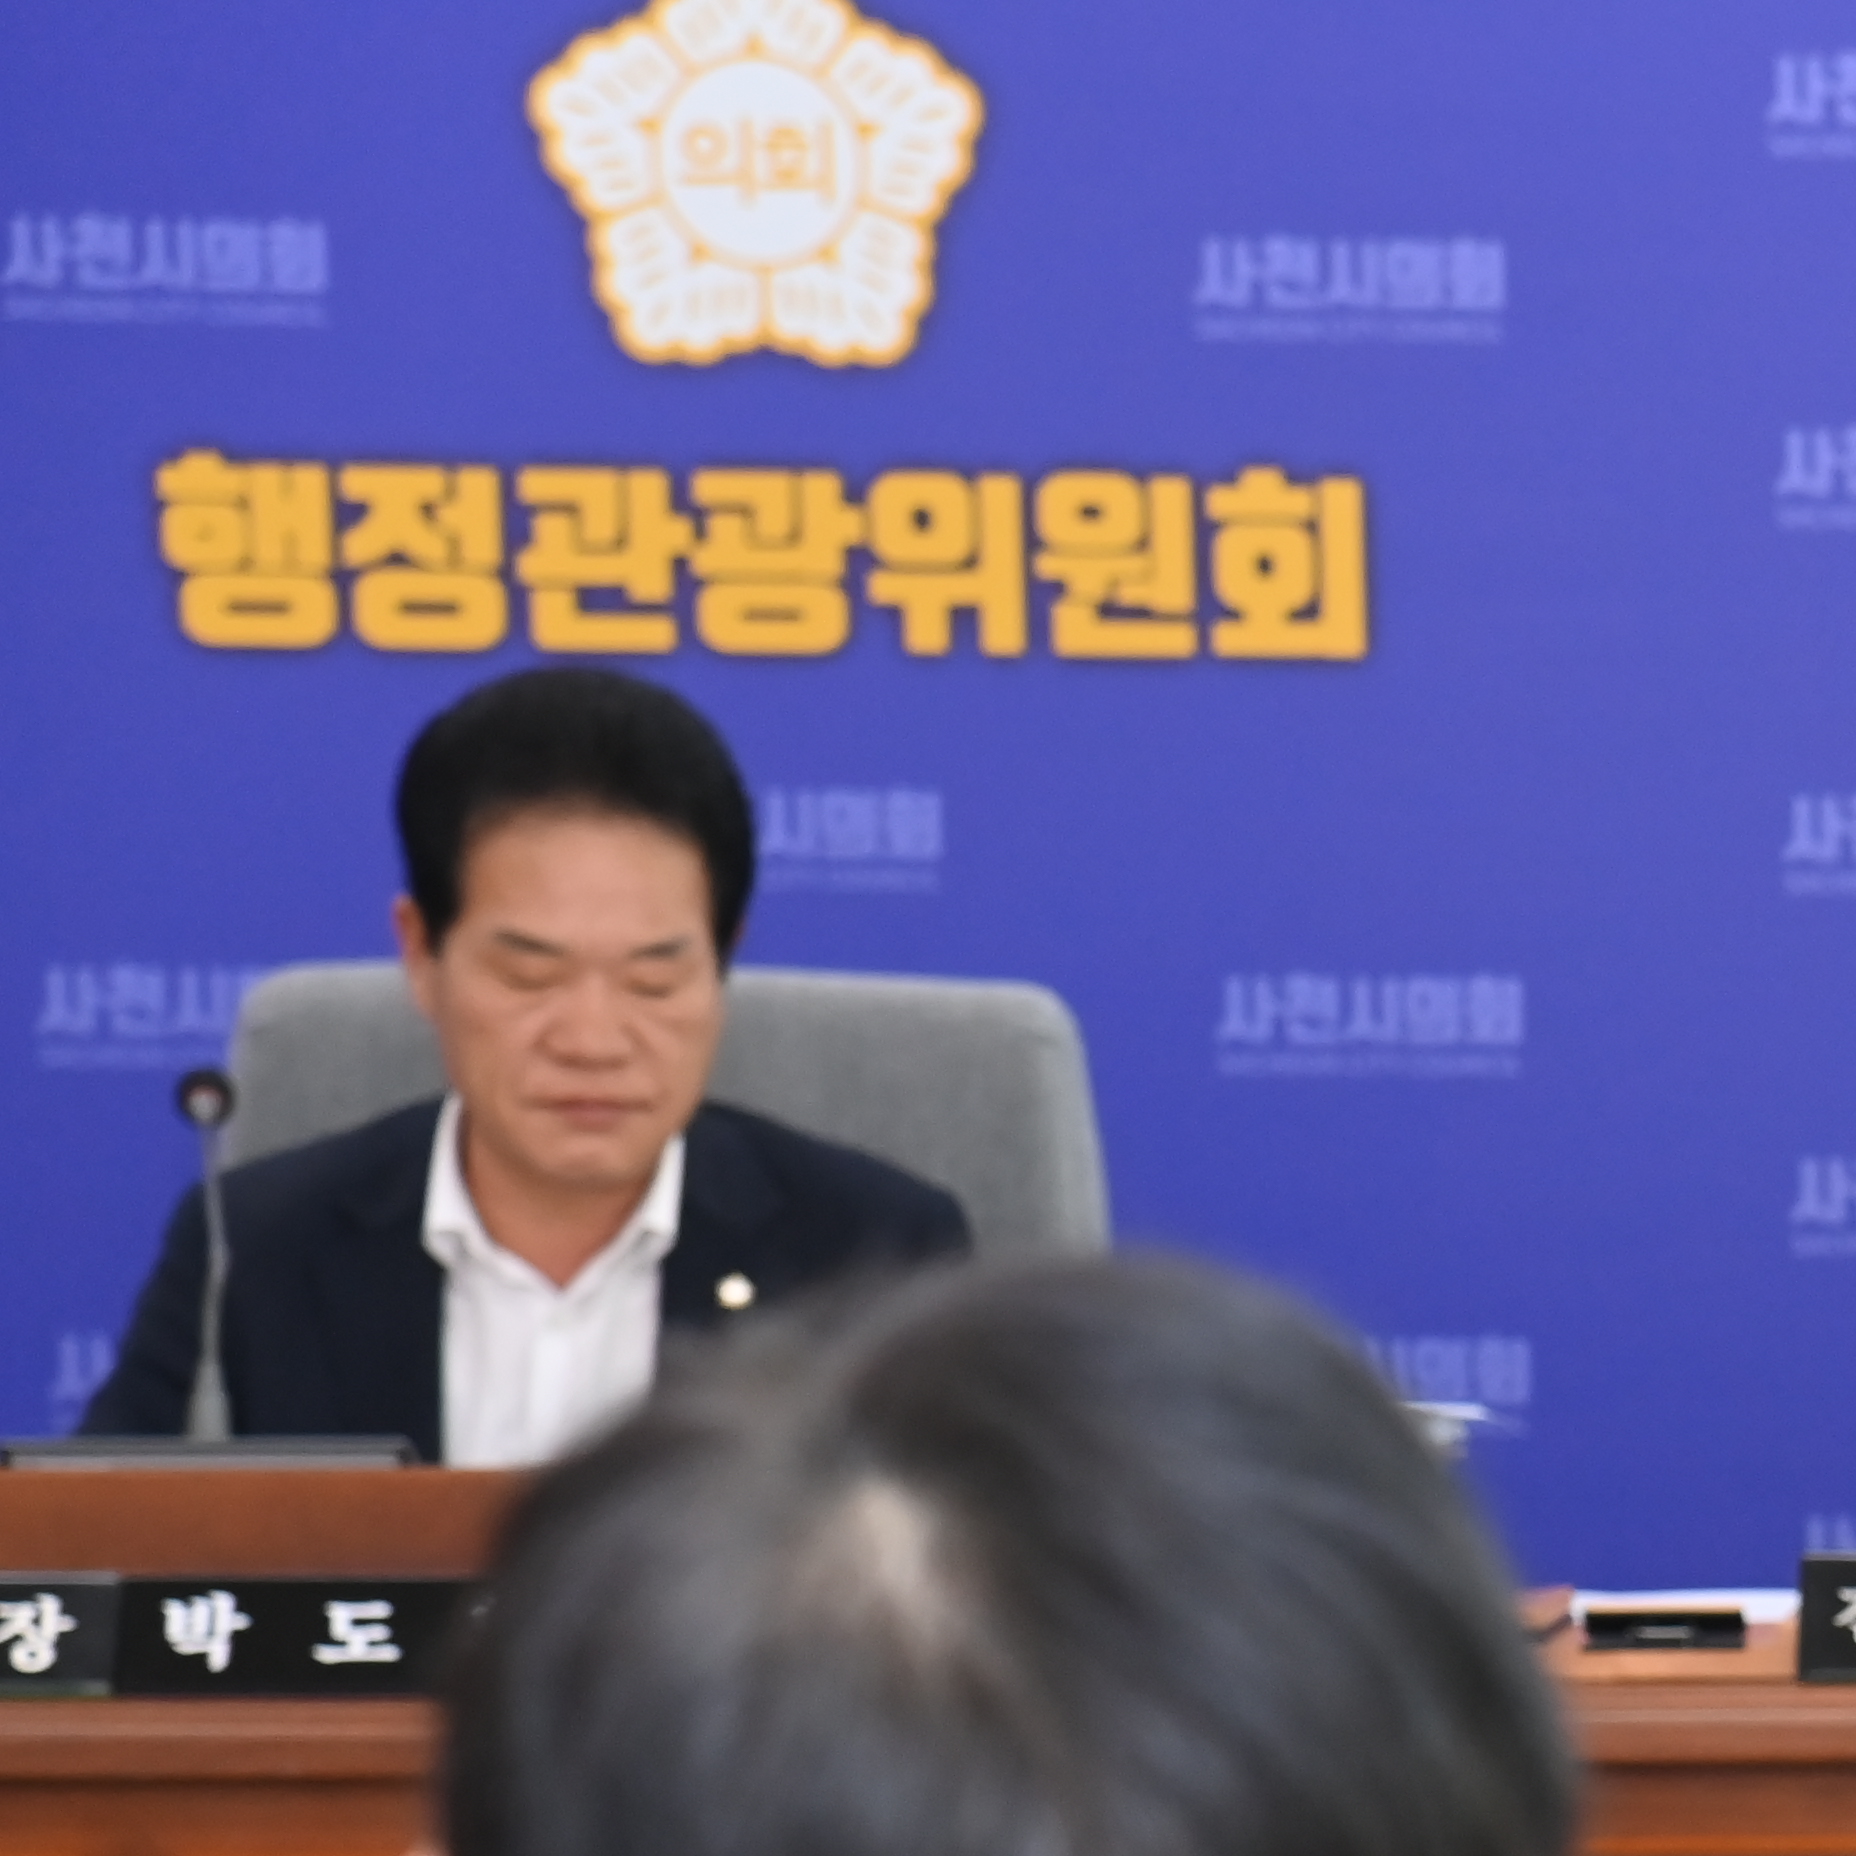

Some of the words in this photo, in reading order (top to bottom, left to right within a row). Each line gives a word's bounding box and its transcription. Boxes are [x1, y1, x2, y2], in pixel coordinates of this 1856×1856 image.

[681, 120, 840, 206] 의회
[153, 448, 1369, 661] 행정관광위원회
[760, 787, 945, 862] 시의회
[37, 962, 240, 1037] 사천시
